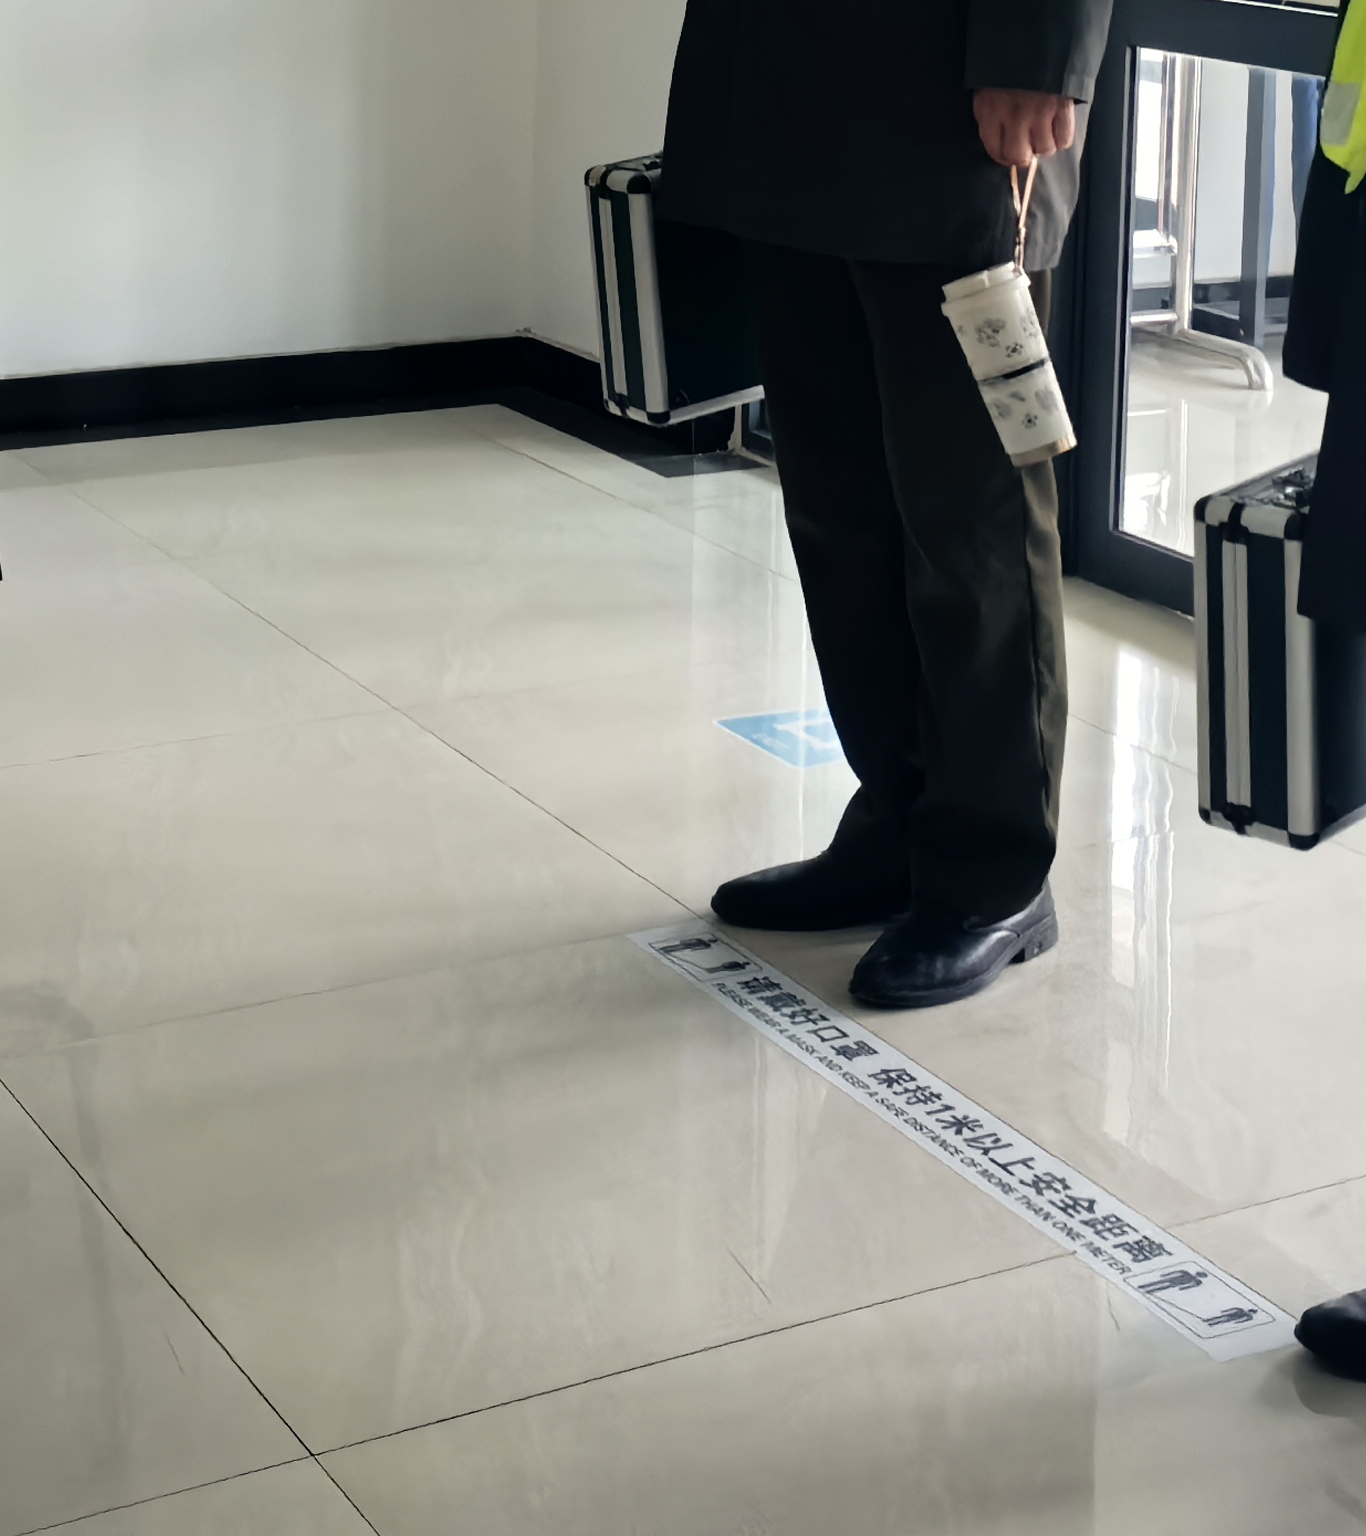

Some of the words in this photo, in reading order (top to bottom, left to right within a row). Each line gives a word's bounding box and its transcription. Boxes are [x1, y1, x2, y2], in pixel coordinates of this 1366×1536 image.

[868, 1068, 1173, 1263] 保持1米以上安全距离
[902, 1117, 965, 1158] DISTANCE
[976, 1168, 1019, 1196] MORE
[1014, 1194, 1056, 1222] THAN
[1051, 1219, 1086, 1242] ONE
[1081, 1241, 1133, 1276] METER
